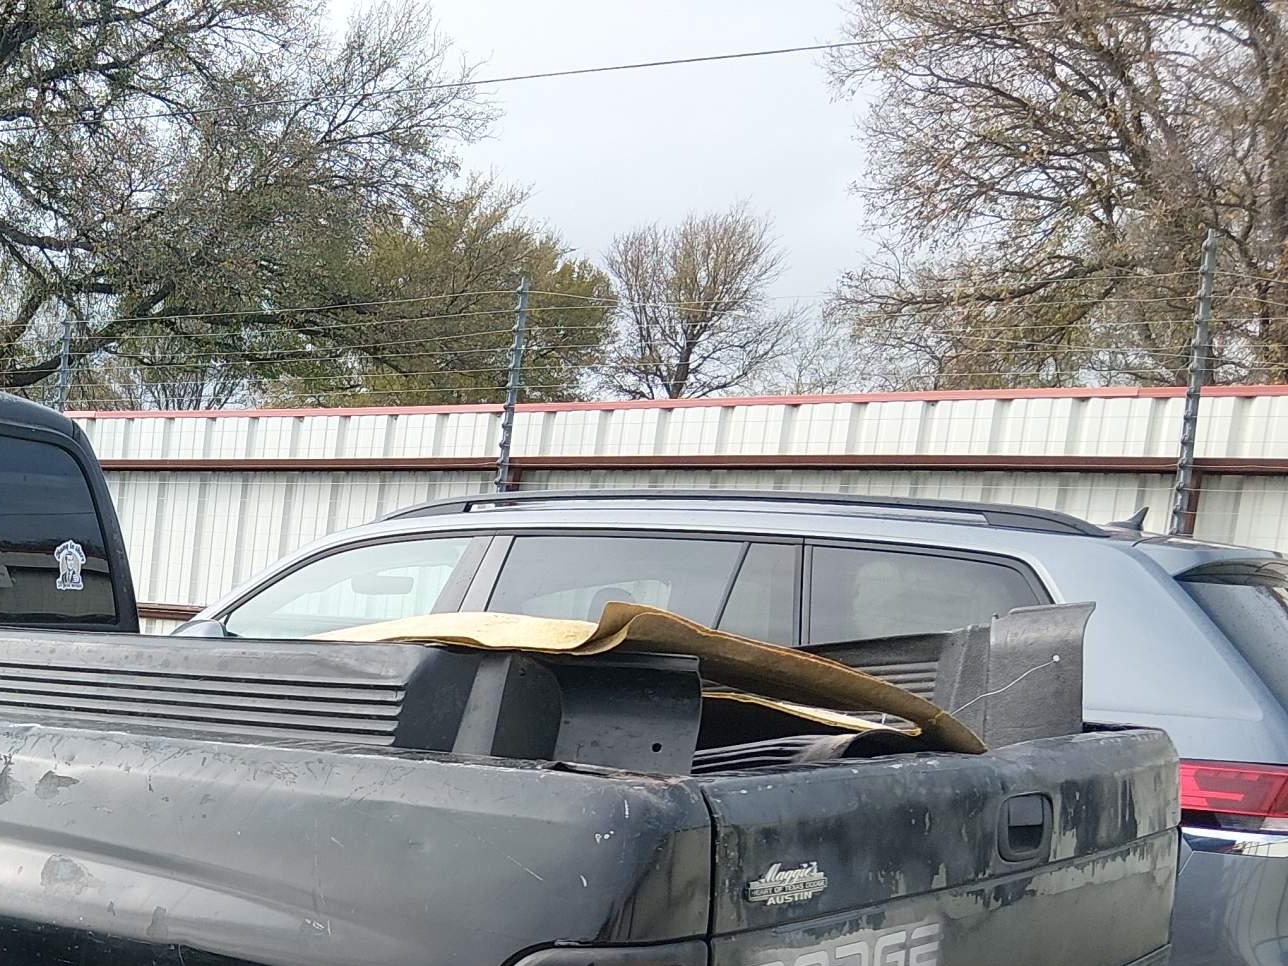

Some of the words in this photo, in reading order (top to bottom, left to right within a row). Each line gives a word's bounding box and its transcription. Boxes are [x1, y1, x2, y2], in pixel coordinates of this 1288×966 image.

[751, 886, 773, 896] HEART
[774, 886, 783, 895] OF
[766, 891, 813, 906] AUSTIN
